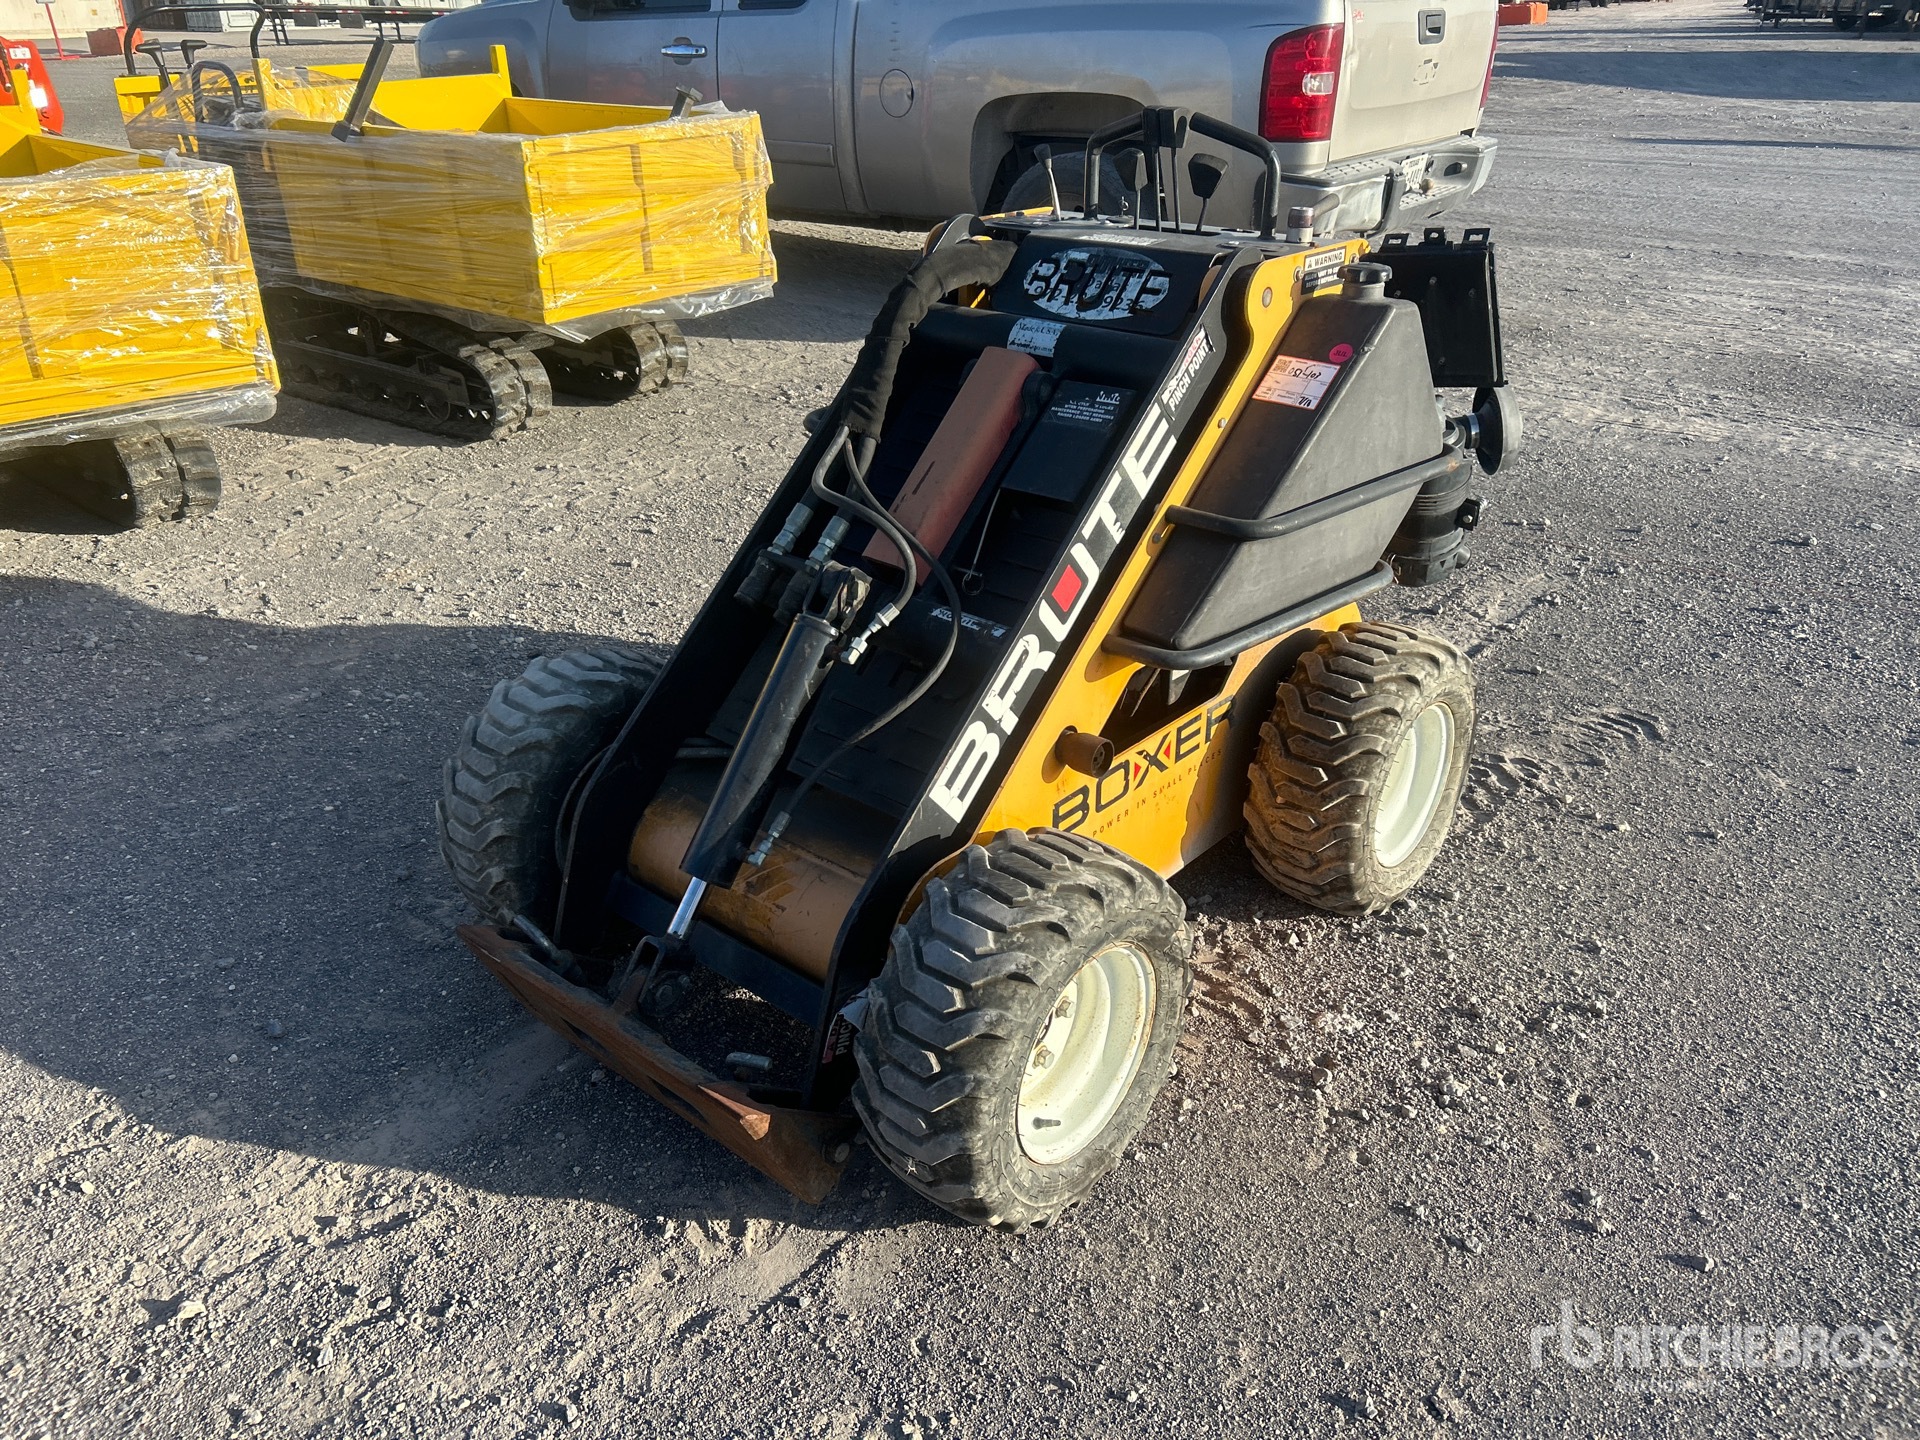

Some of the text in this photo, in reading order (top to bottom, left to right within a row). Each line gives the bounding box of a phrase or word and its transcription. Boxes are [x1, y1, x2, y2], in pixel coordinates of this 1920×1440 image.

[1024, 257, 1174, 317] BRUTE
[1314, 252, 1343, 267] WARNING
[1168, 338, 1210, 413] PINCH POINT
[929, 403, 1177, 823] BRUTE
[1052, 694, 1234, 833] BOXER
[1092, 749, 1223, 838] POWER IN SMALL PLACES
